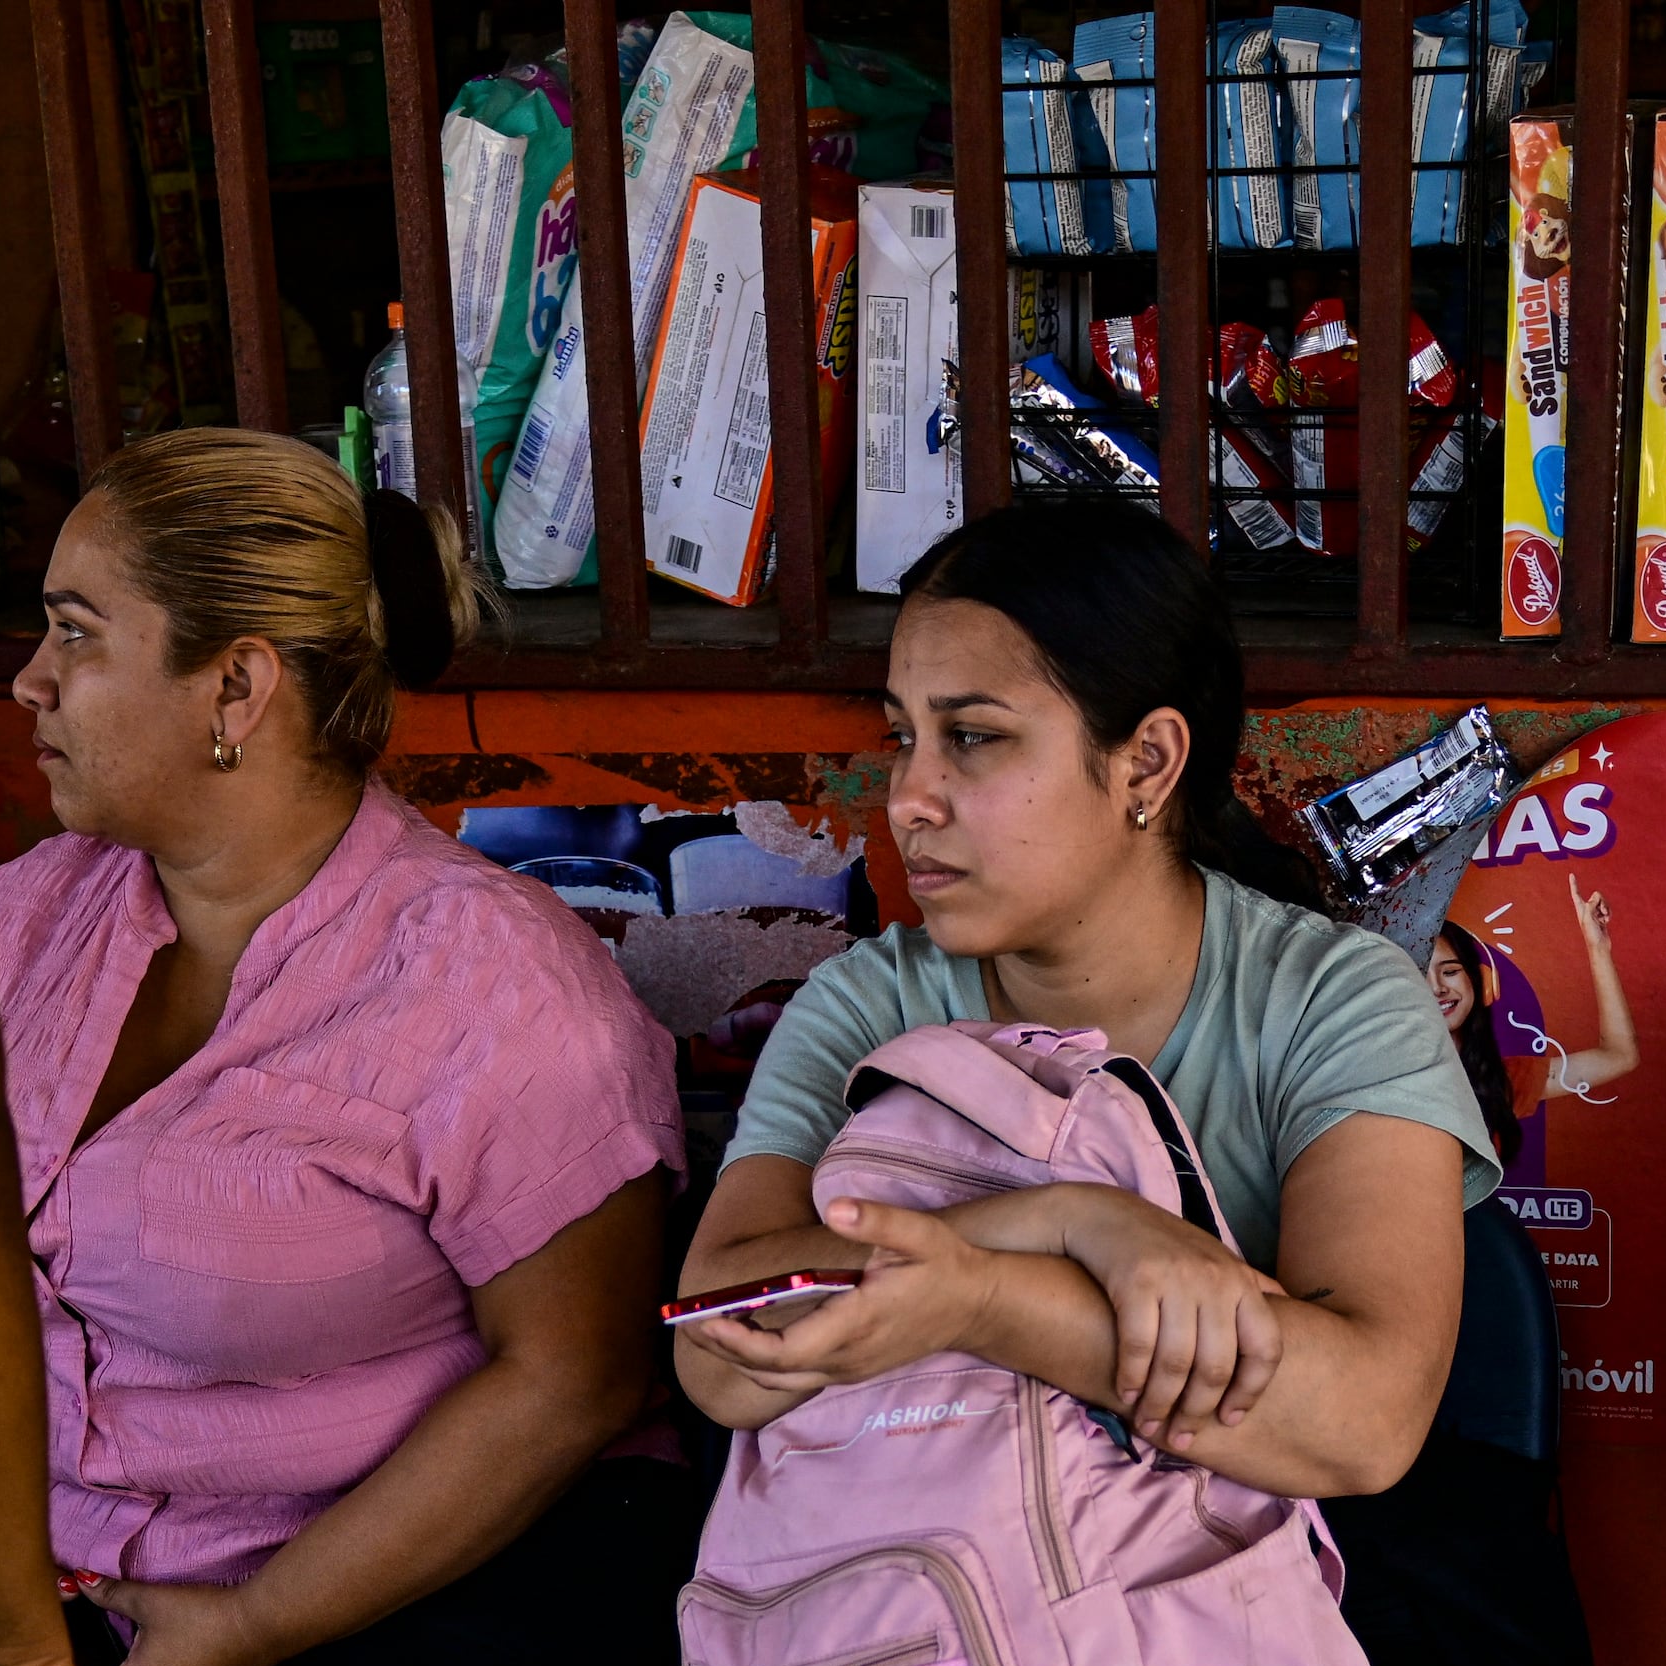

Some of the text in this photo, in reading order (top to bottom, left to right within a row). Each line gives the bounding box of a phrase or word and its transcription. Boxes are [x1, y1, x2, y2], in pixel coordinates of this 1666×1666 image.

[1517, 284, 1558, 417] Sandwich
[1516, 552, 1554, 612] Pascual
[1550, 1201, 1578, 1218] LTE
[1554, 1252, 1600, 1267] DATA
[862, 1399, 968, 1431] FASHION
